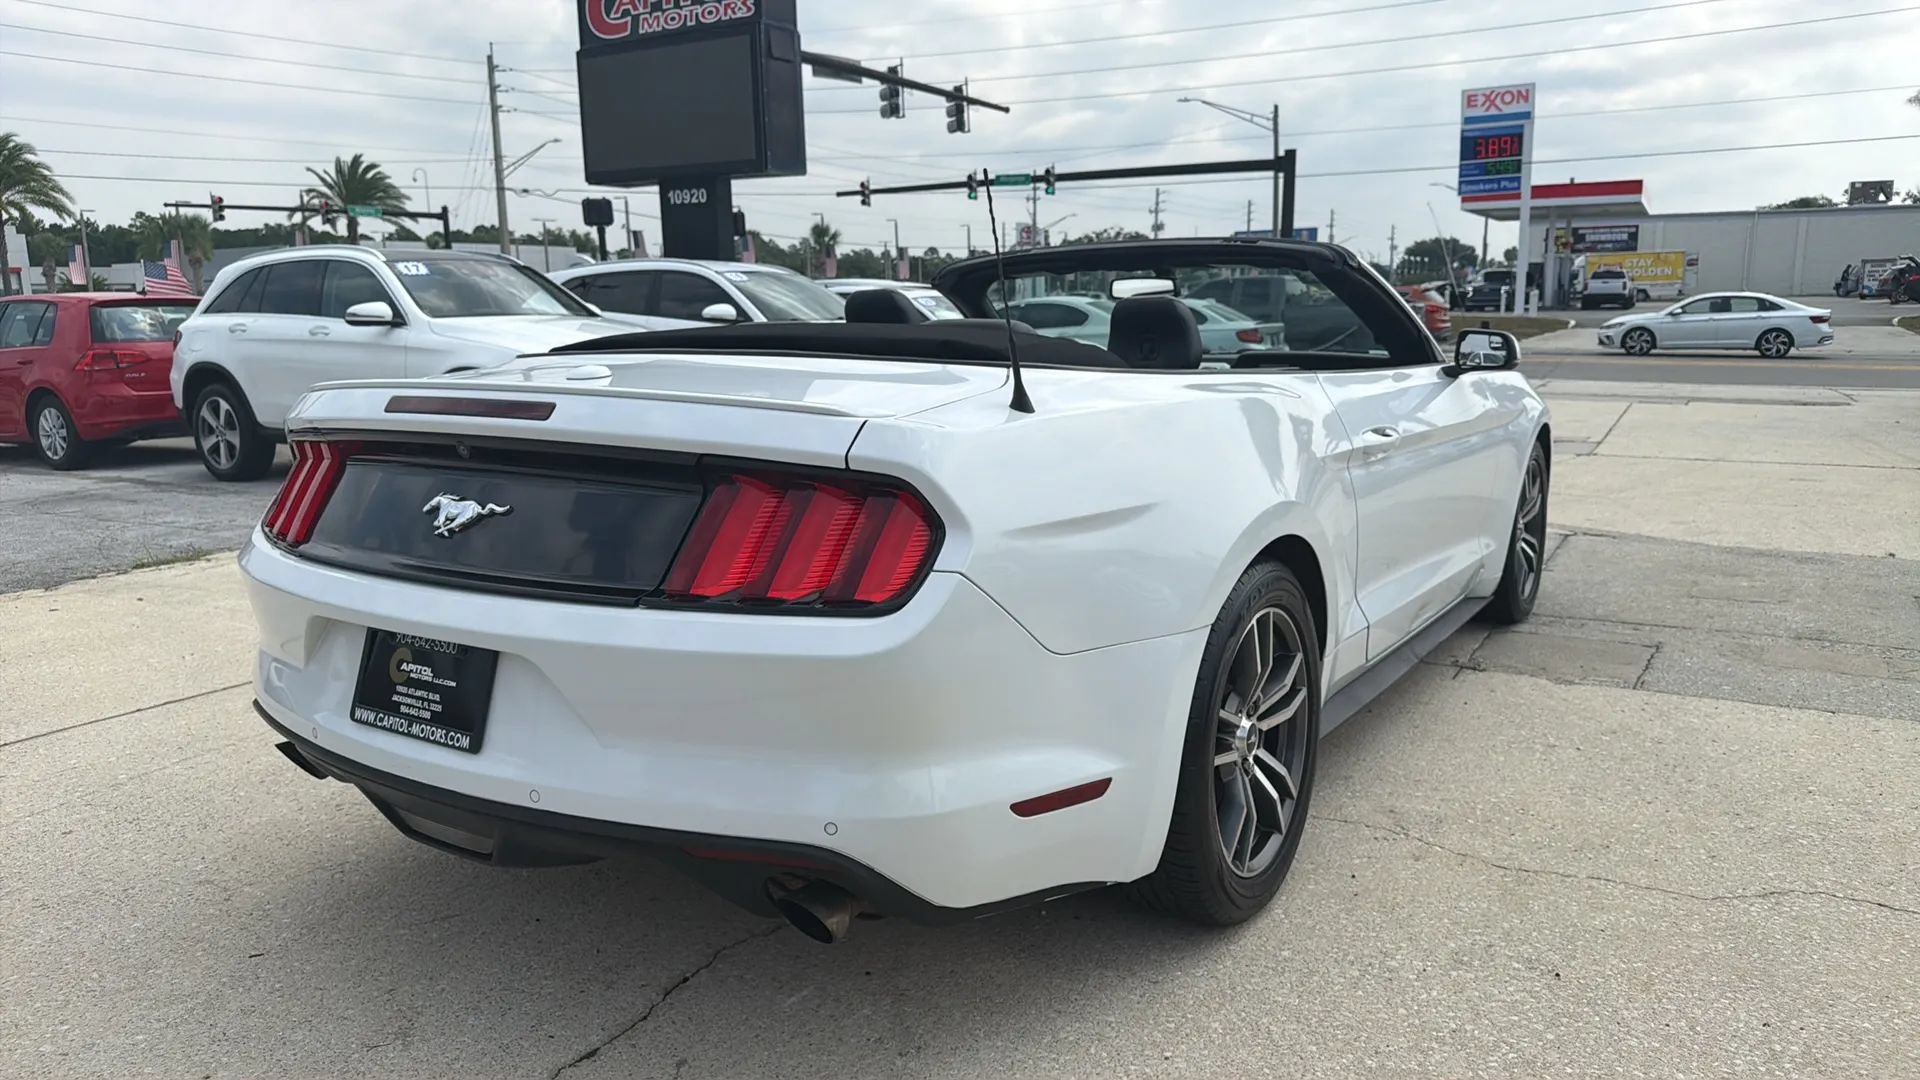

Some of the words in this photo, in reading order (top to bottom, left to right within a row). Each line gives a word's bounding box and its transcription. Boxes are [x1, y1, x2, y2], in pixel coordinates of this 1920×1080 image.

[639, 0, 755, 34] MOTORS
[1466, 88, 1530, 113] EXXON
[1500, 179, 1519, 190] Plus
[667, 187, 708, 205] 10920
[1624, 257, 1655, 267] STAY
[403, 264, 420, 273] 17
[409, 672, 433, 682] MOTORS
[408, 687, 428, 699] ATLANTIC
[423, 701, 429, 709] FL
[354, 707, 470, 750] WWW.CAPITOL-MOTORS.COM
